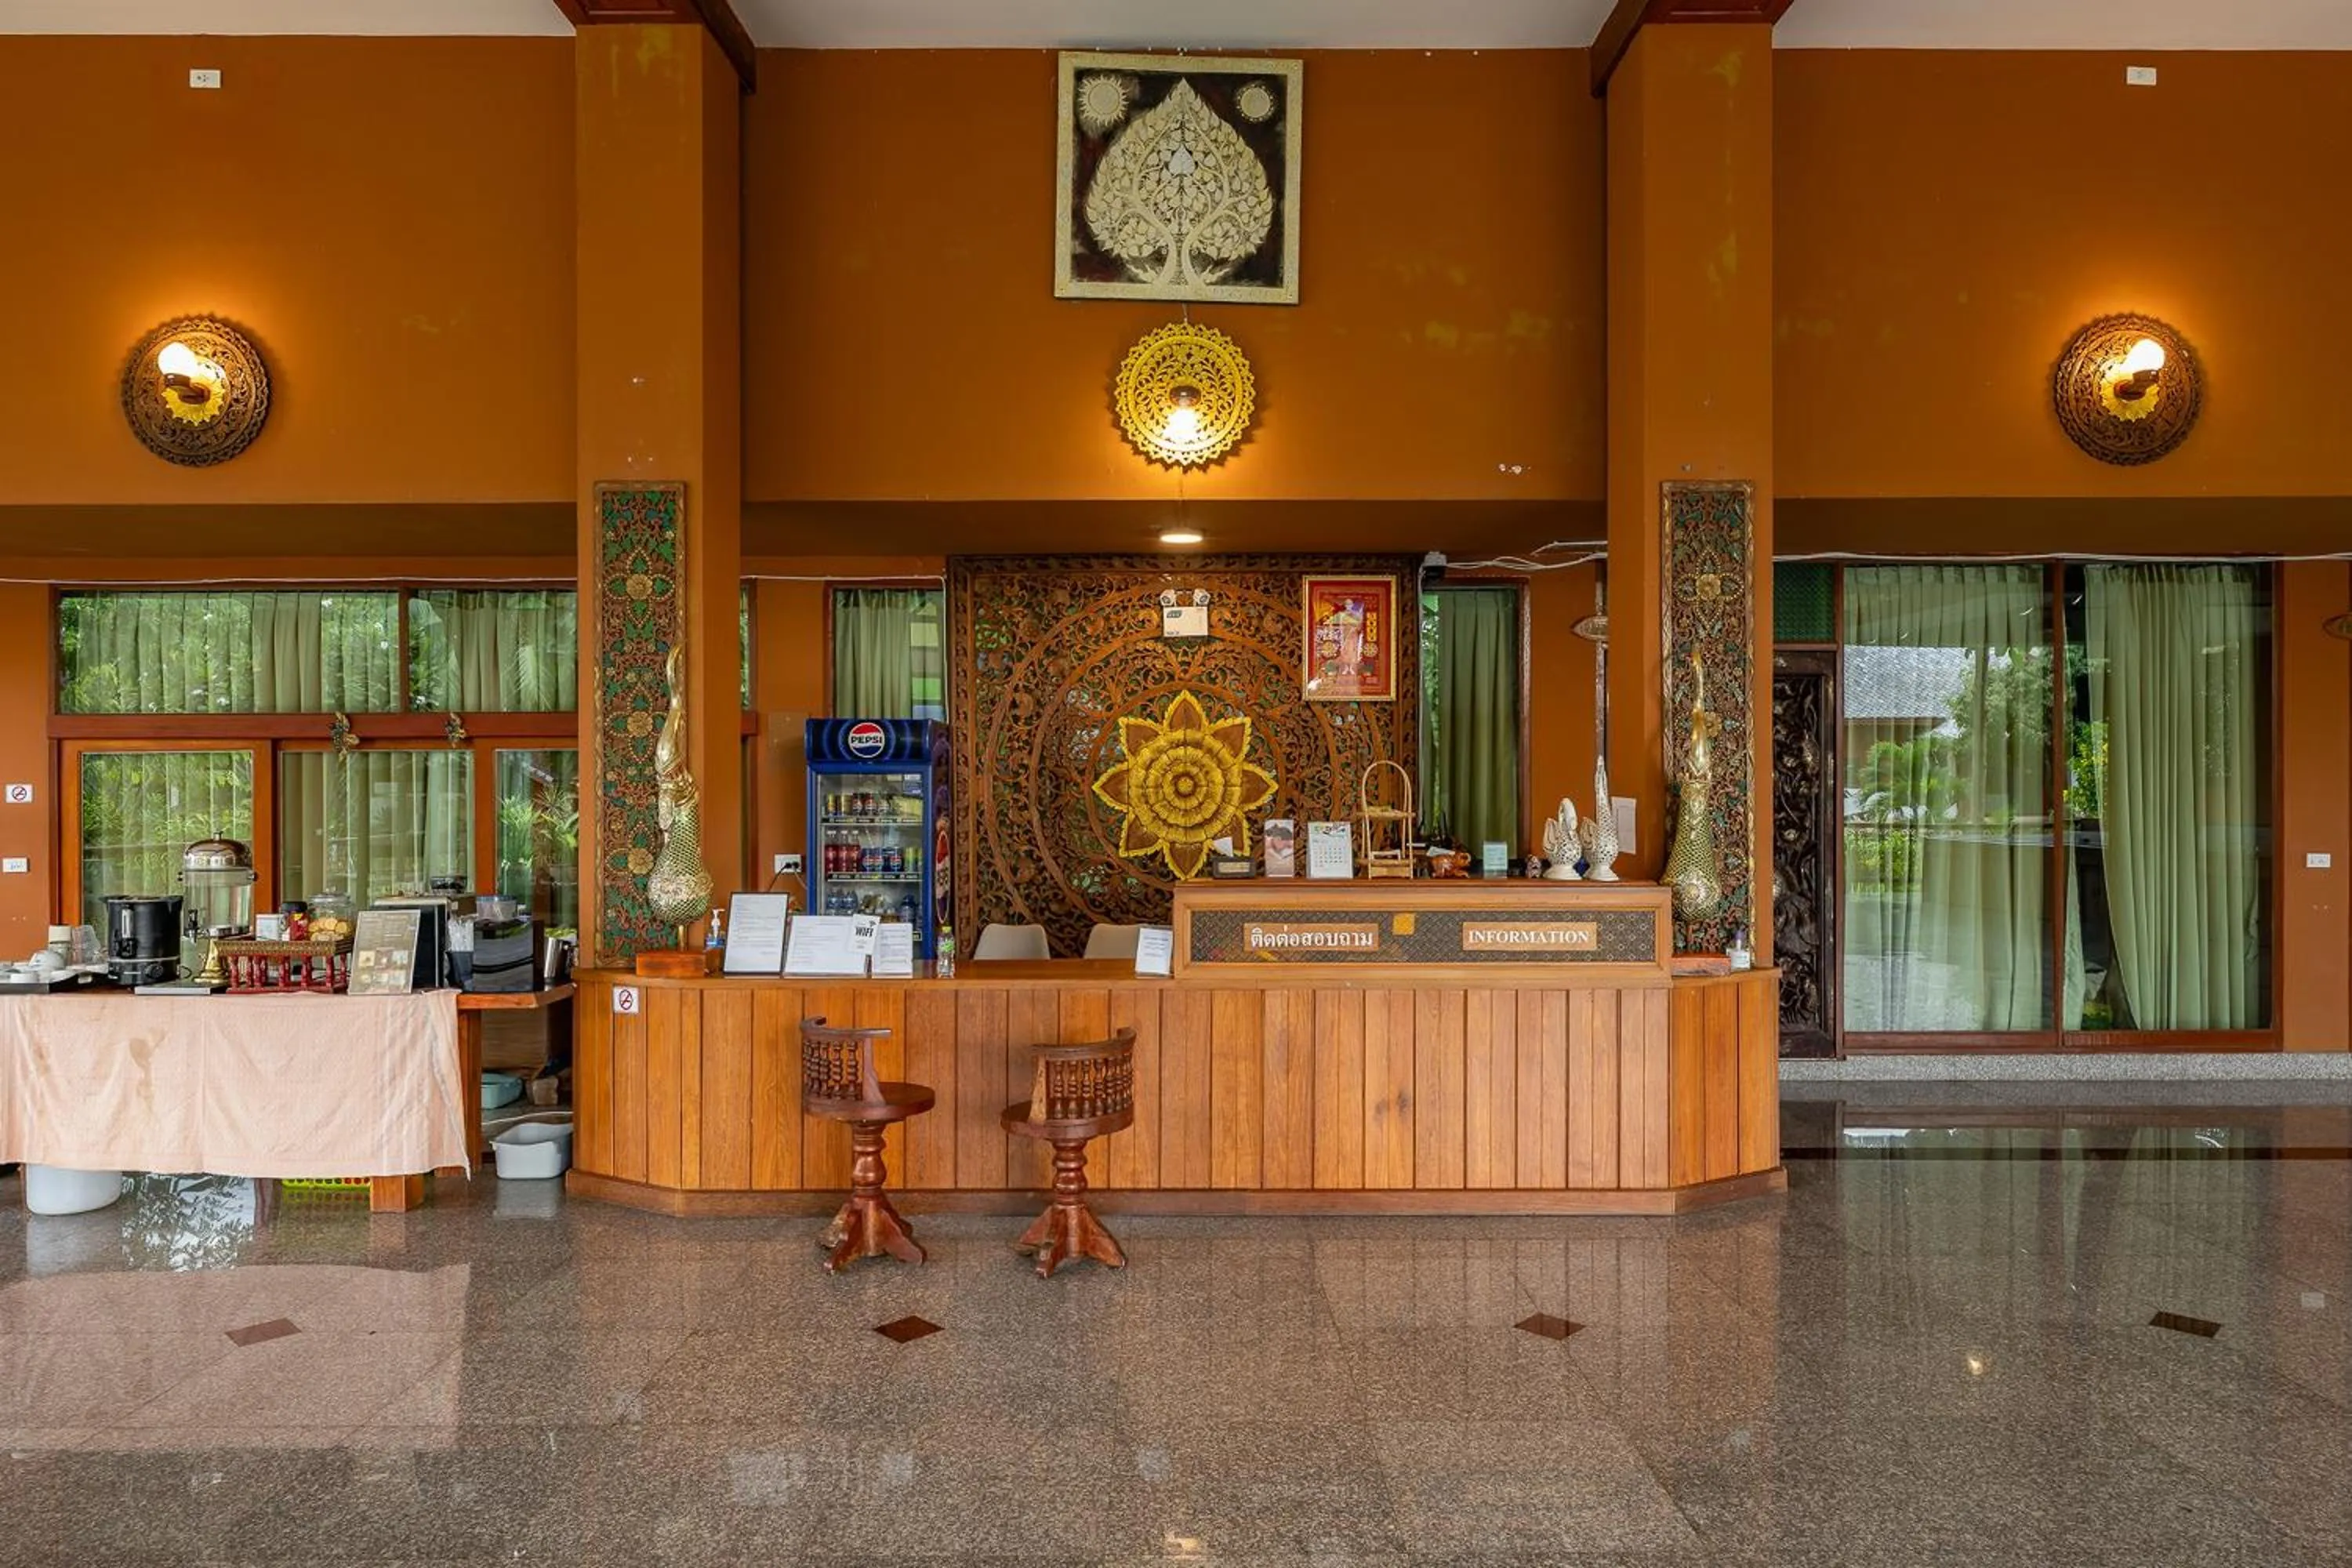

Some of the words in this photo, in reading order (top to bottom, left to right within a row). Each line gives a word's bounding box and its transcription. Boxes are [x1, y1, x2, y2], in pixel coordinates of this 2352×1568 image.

[851, 735, 883, 744] PEPSI
[1250, 924, 1373, 947] ติดต่อสอบถาม
[1468, 931, 1589, 943] INFORMATION
